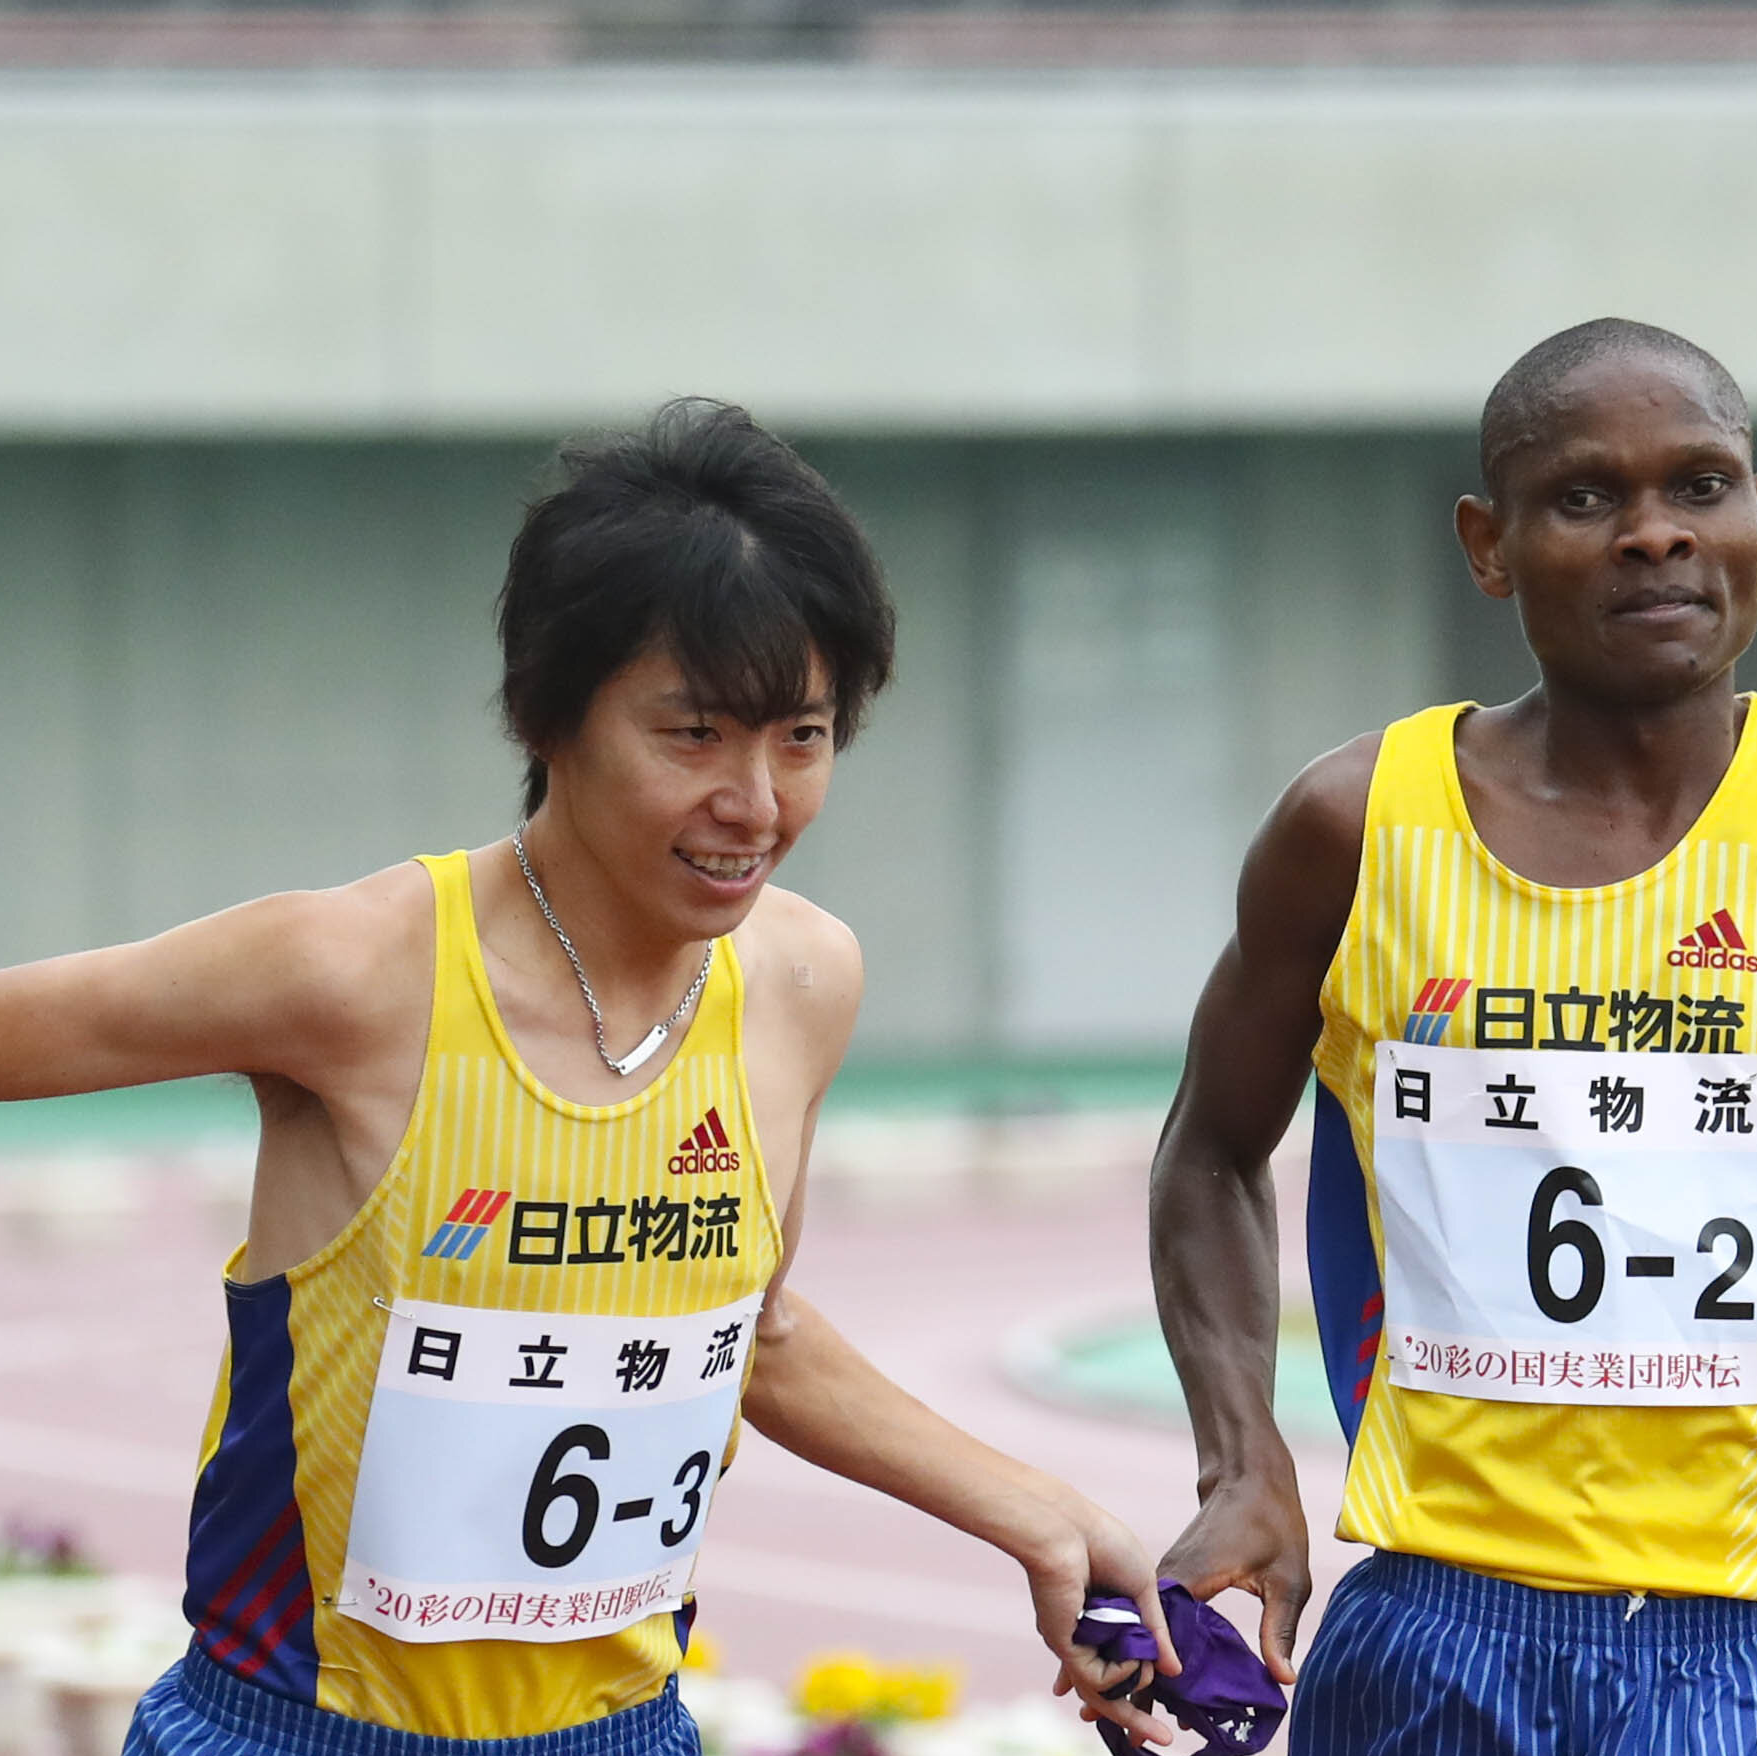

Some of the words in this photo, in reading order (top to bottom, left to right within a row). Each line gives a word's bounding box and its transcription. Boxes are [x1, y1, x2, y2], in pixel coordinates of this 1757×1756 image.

[1475, 986, 1745, 1054] 日立物流
[1394, 1068, 1755, 1134] 日立物流
[667, 1148, 740, 1175] adidas
[508, 1192, 741, 1265] 日立物流
[1527, 1166, 1755, 1323] 6-2
[407, 1320, 743, 1393] 日立物流
[522, 1424, 711, 1569] 6-3
